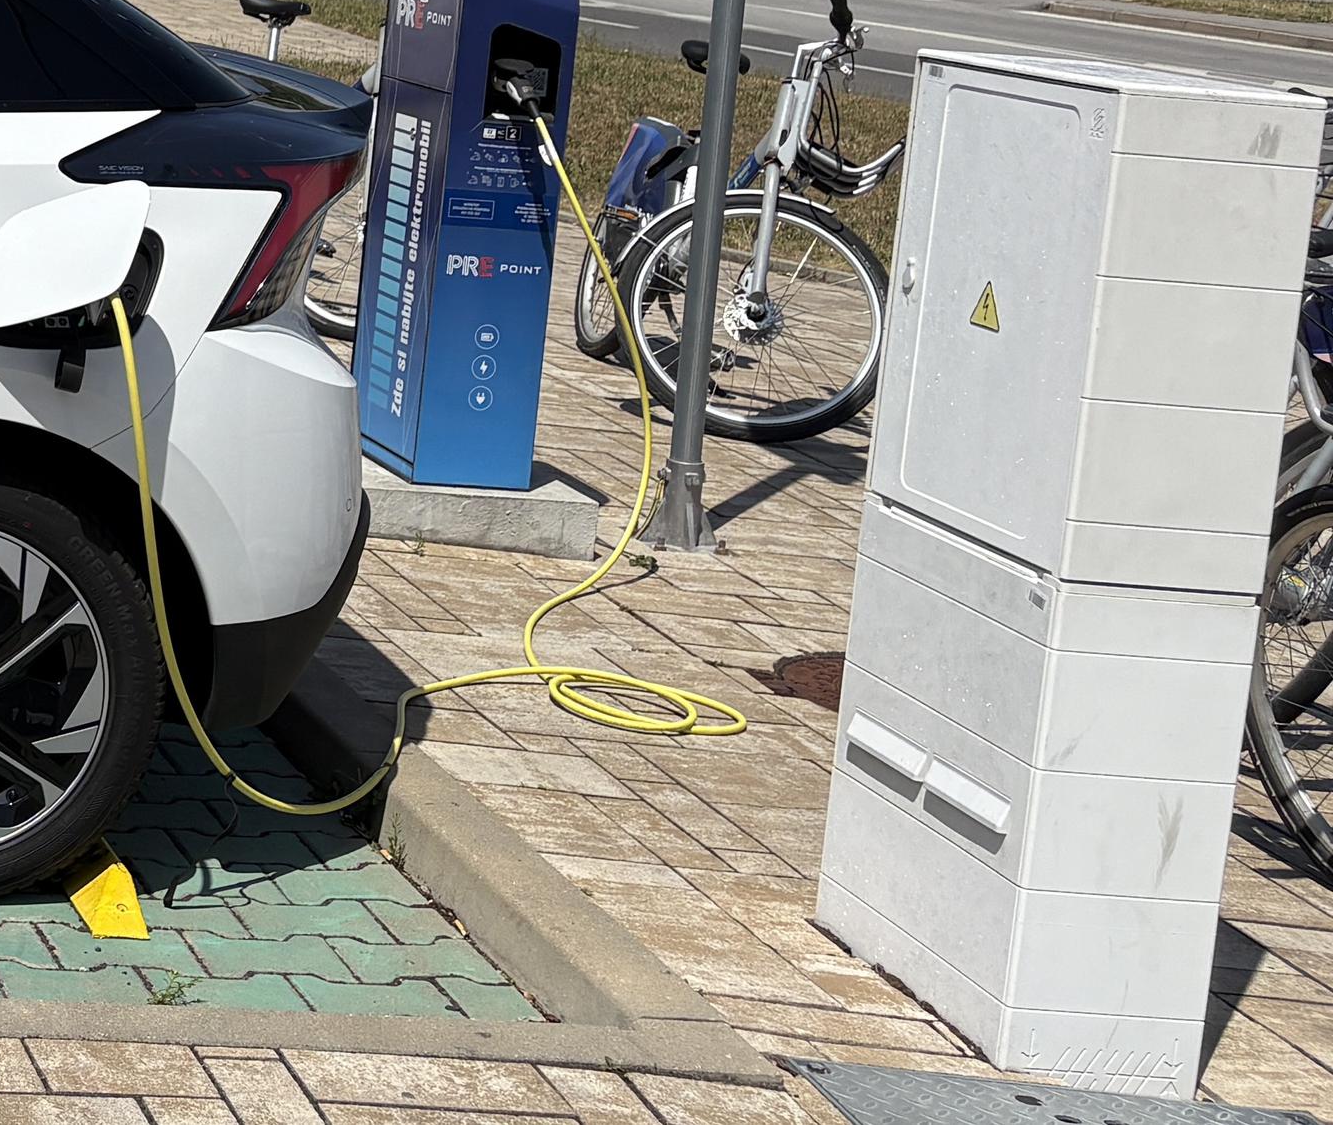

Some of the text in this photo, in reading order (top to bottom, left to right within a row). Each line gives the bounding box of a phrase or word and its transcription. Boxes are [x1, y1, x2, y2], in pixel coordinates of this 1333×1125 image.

[426, 11, 452, 26] POINT
[509, 128, 518, 139] 2
[406, 120, 432, 263] elektromobil
[499, 263, 542, 275] POINT
[390, 377, 405, 418] Zde
